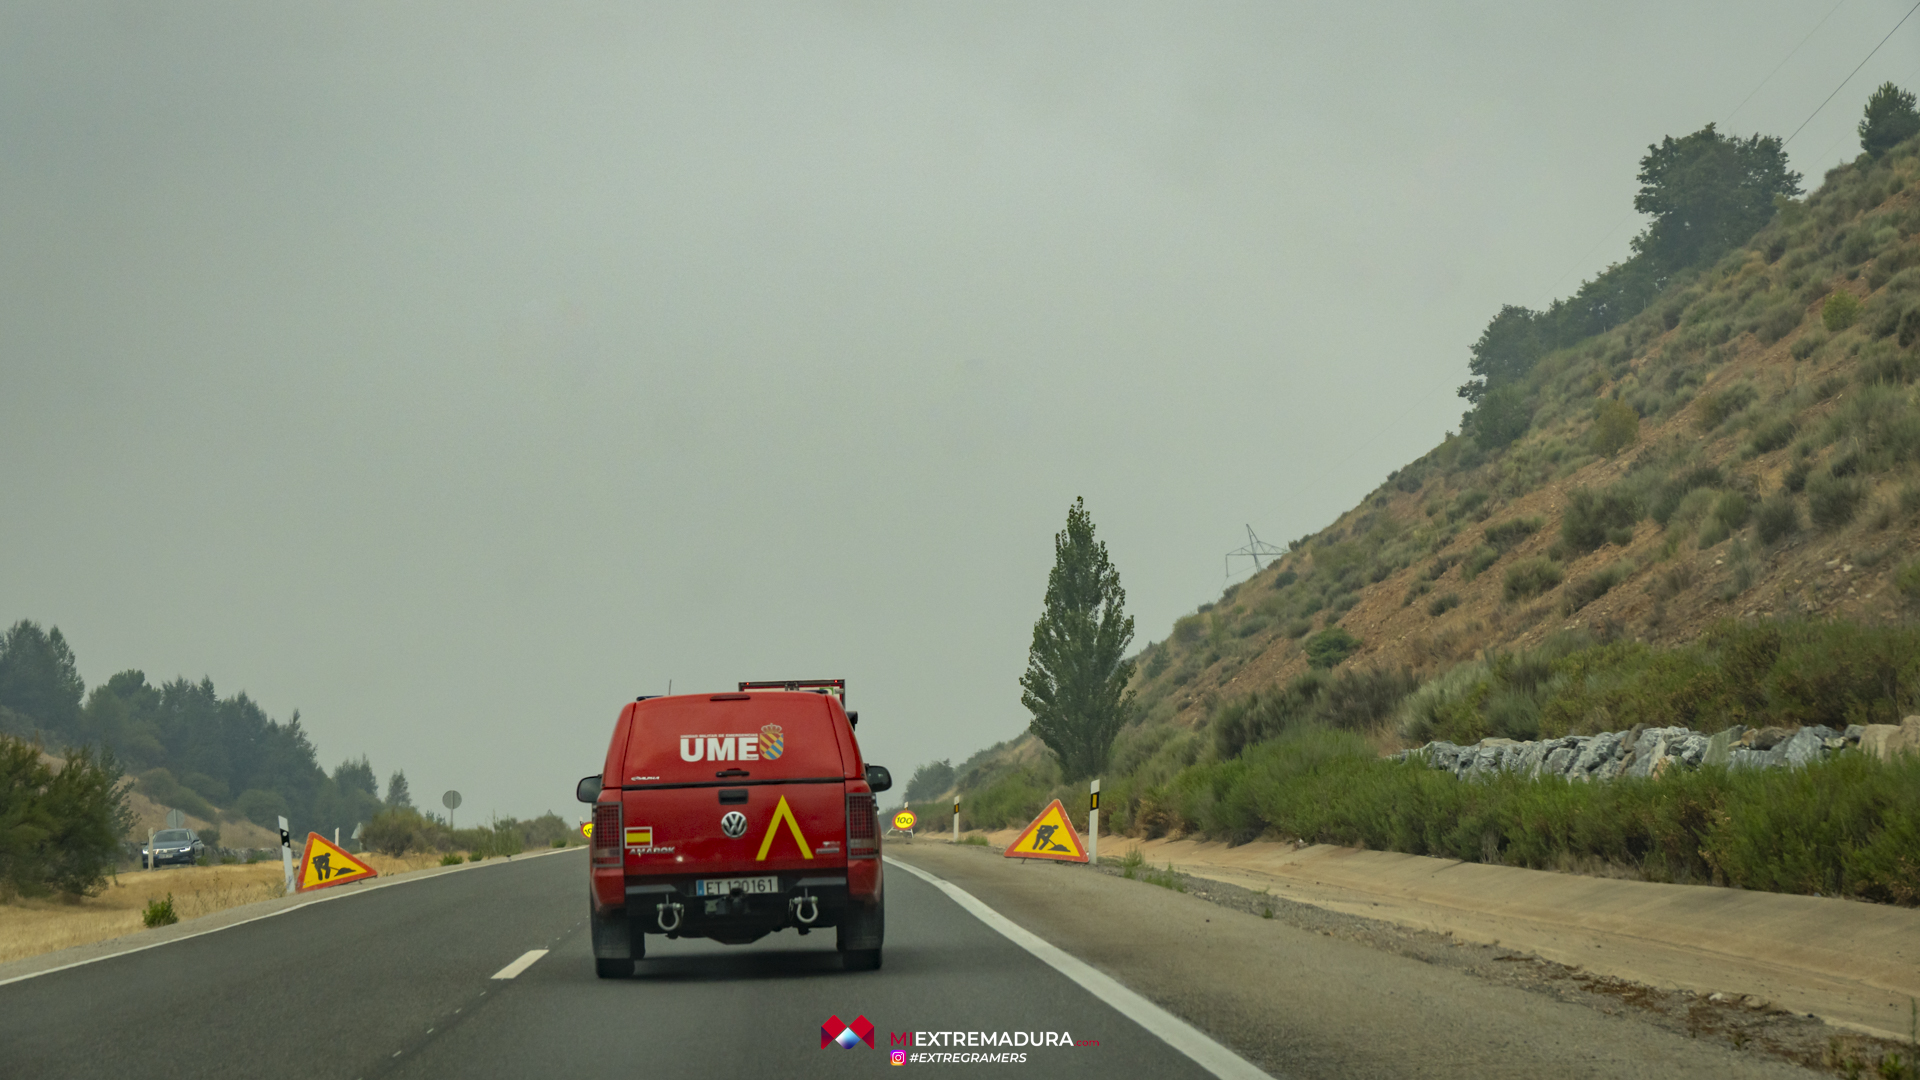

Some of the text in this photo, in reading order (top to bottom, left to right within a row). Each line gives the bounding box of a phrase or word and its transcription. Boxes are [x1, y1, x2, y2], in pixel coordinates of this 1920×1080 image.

[680, 737, 759, 762] UME
[897, 816, 913, 824] 100
[706, 881, 722, 895] ET
